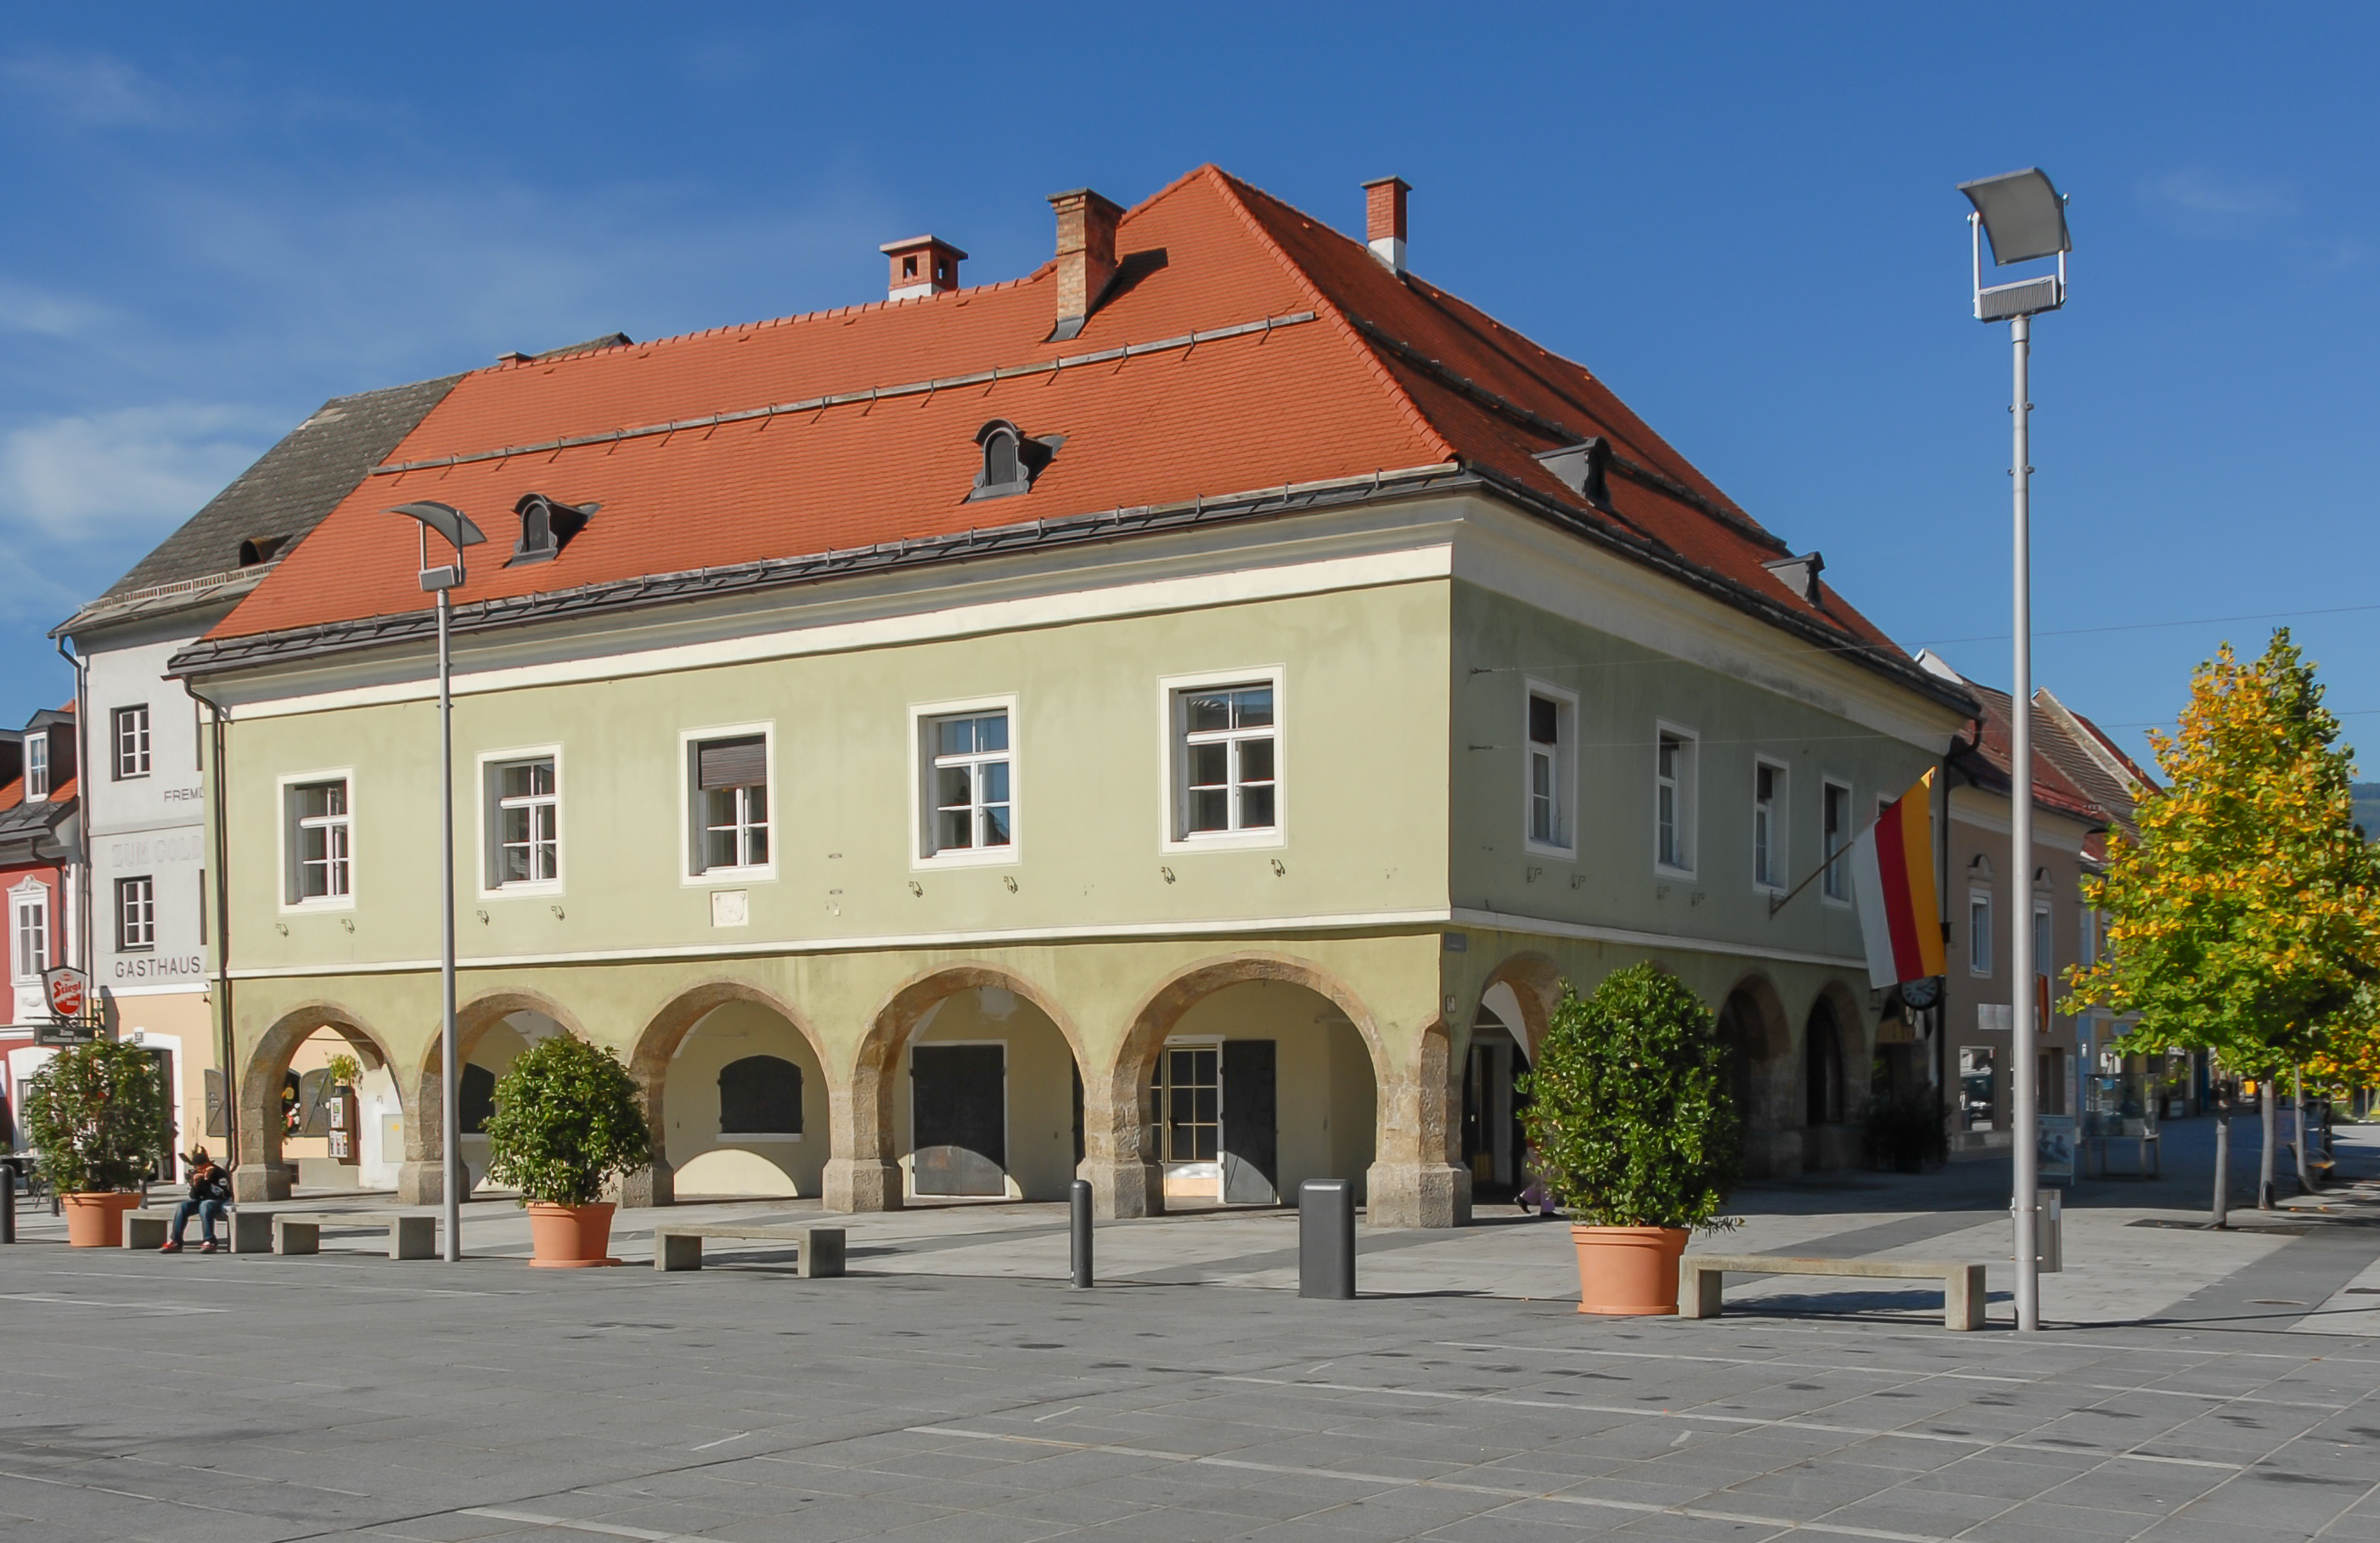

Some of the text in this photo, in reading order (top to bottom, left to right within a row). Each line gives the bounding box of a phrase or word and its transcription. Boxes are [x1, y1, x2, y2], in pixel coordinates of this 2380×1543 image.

[112, 835, 204, 867] ZUM GOLD
[115, 956, 200, 978] GASTHAUS
[53, 980, 81, 999] Stiegl
